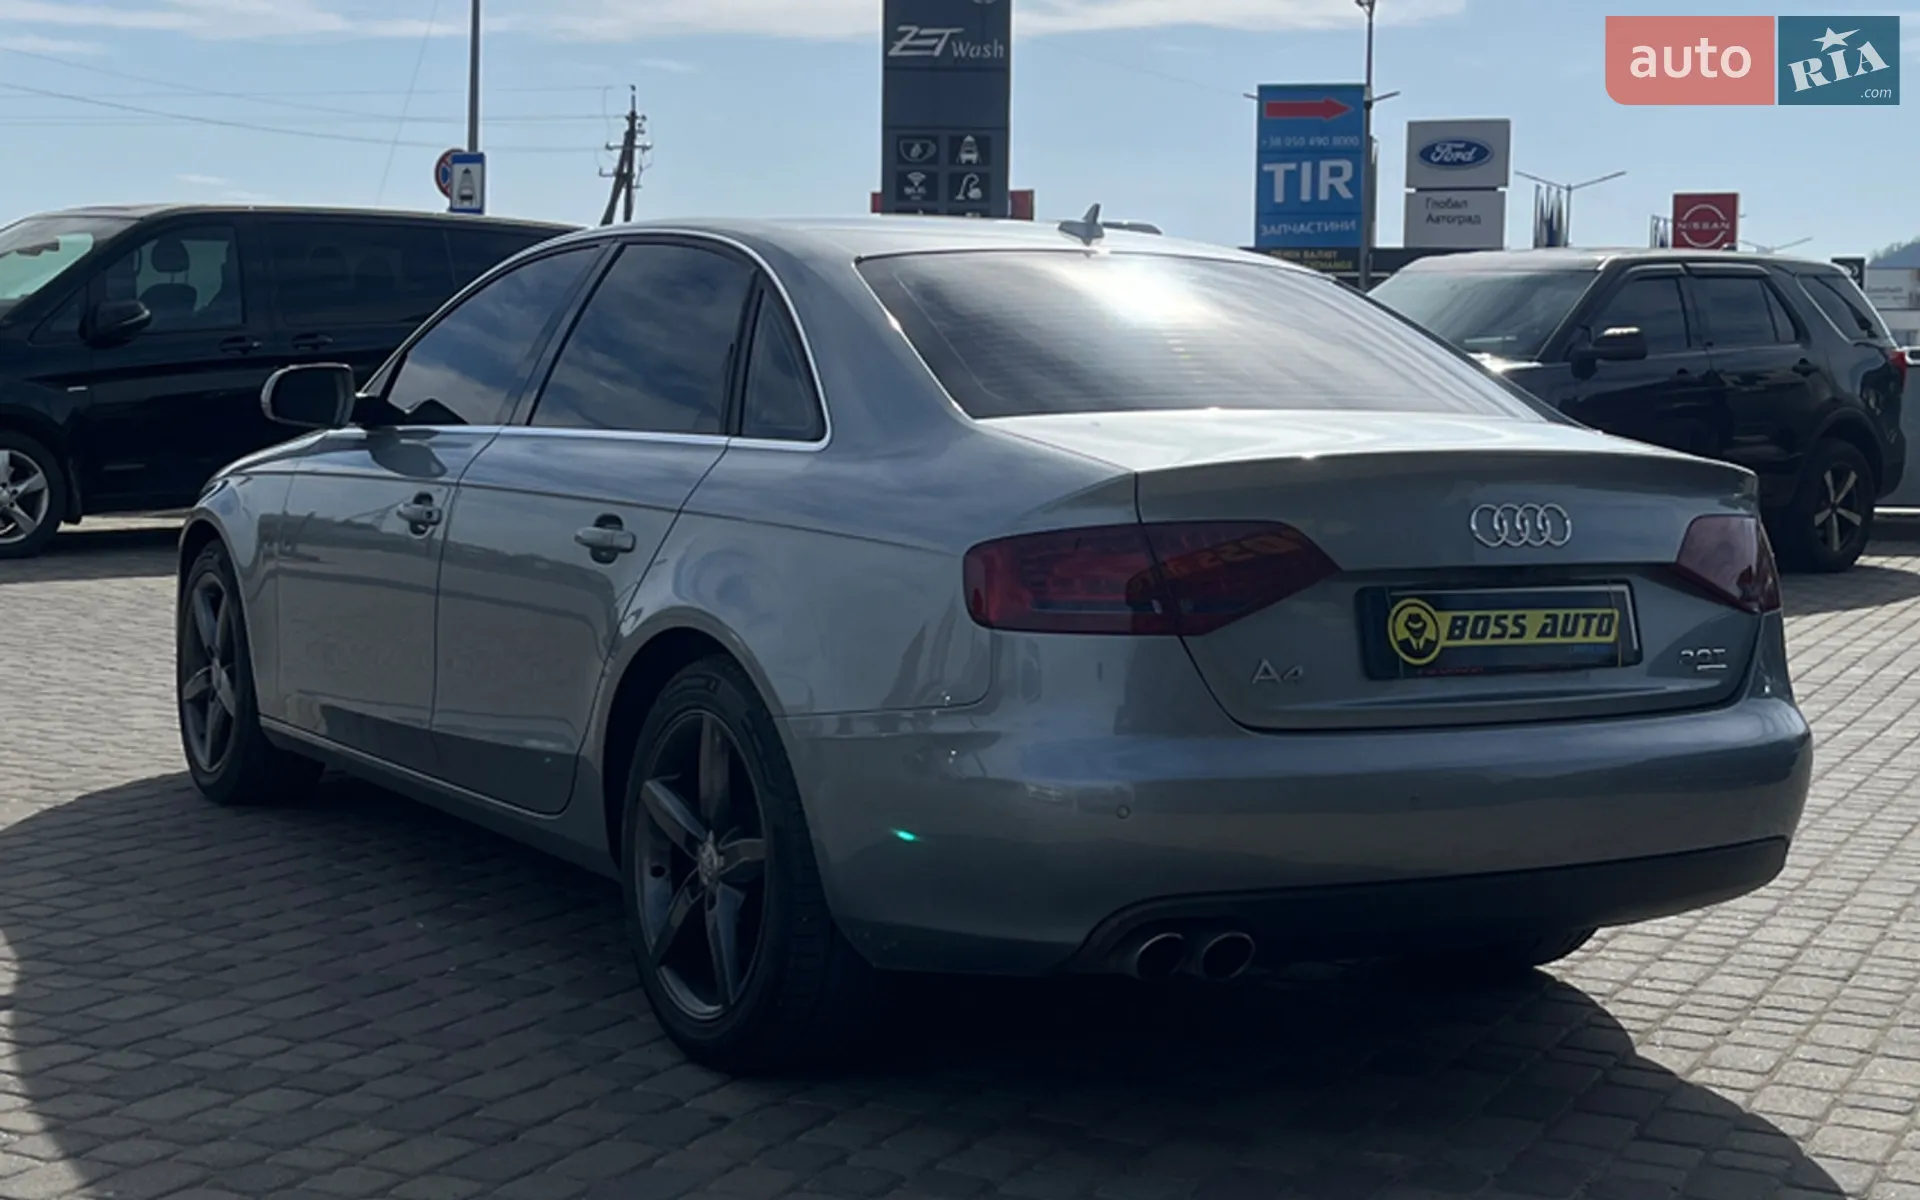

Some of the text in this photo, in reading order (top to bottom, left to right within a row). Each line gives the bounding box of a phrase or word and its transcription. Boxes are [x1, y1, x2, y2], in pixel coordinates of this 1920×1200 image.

[888, 25, 1004, 59] ZET Wash
[1430, 142, 1477, 162] Ford
[1262, 159, 1354, 203] TIR
[1425, 197, 1468, 210] Глобал
[1260, 220, 1357, 237] ЗАПЧАСТИНИ
[1425, 212, 1482, 226] Автоград
[1677, 221, 1730, 230] NISSAN
[1447, 612, 1616, 641] BOSS AUTO
[1252, 658, 1304, 684] A4
